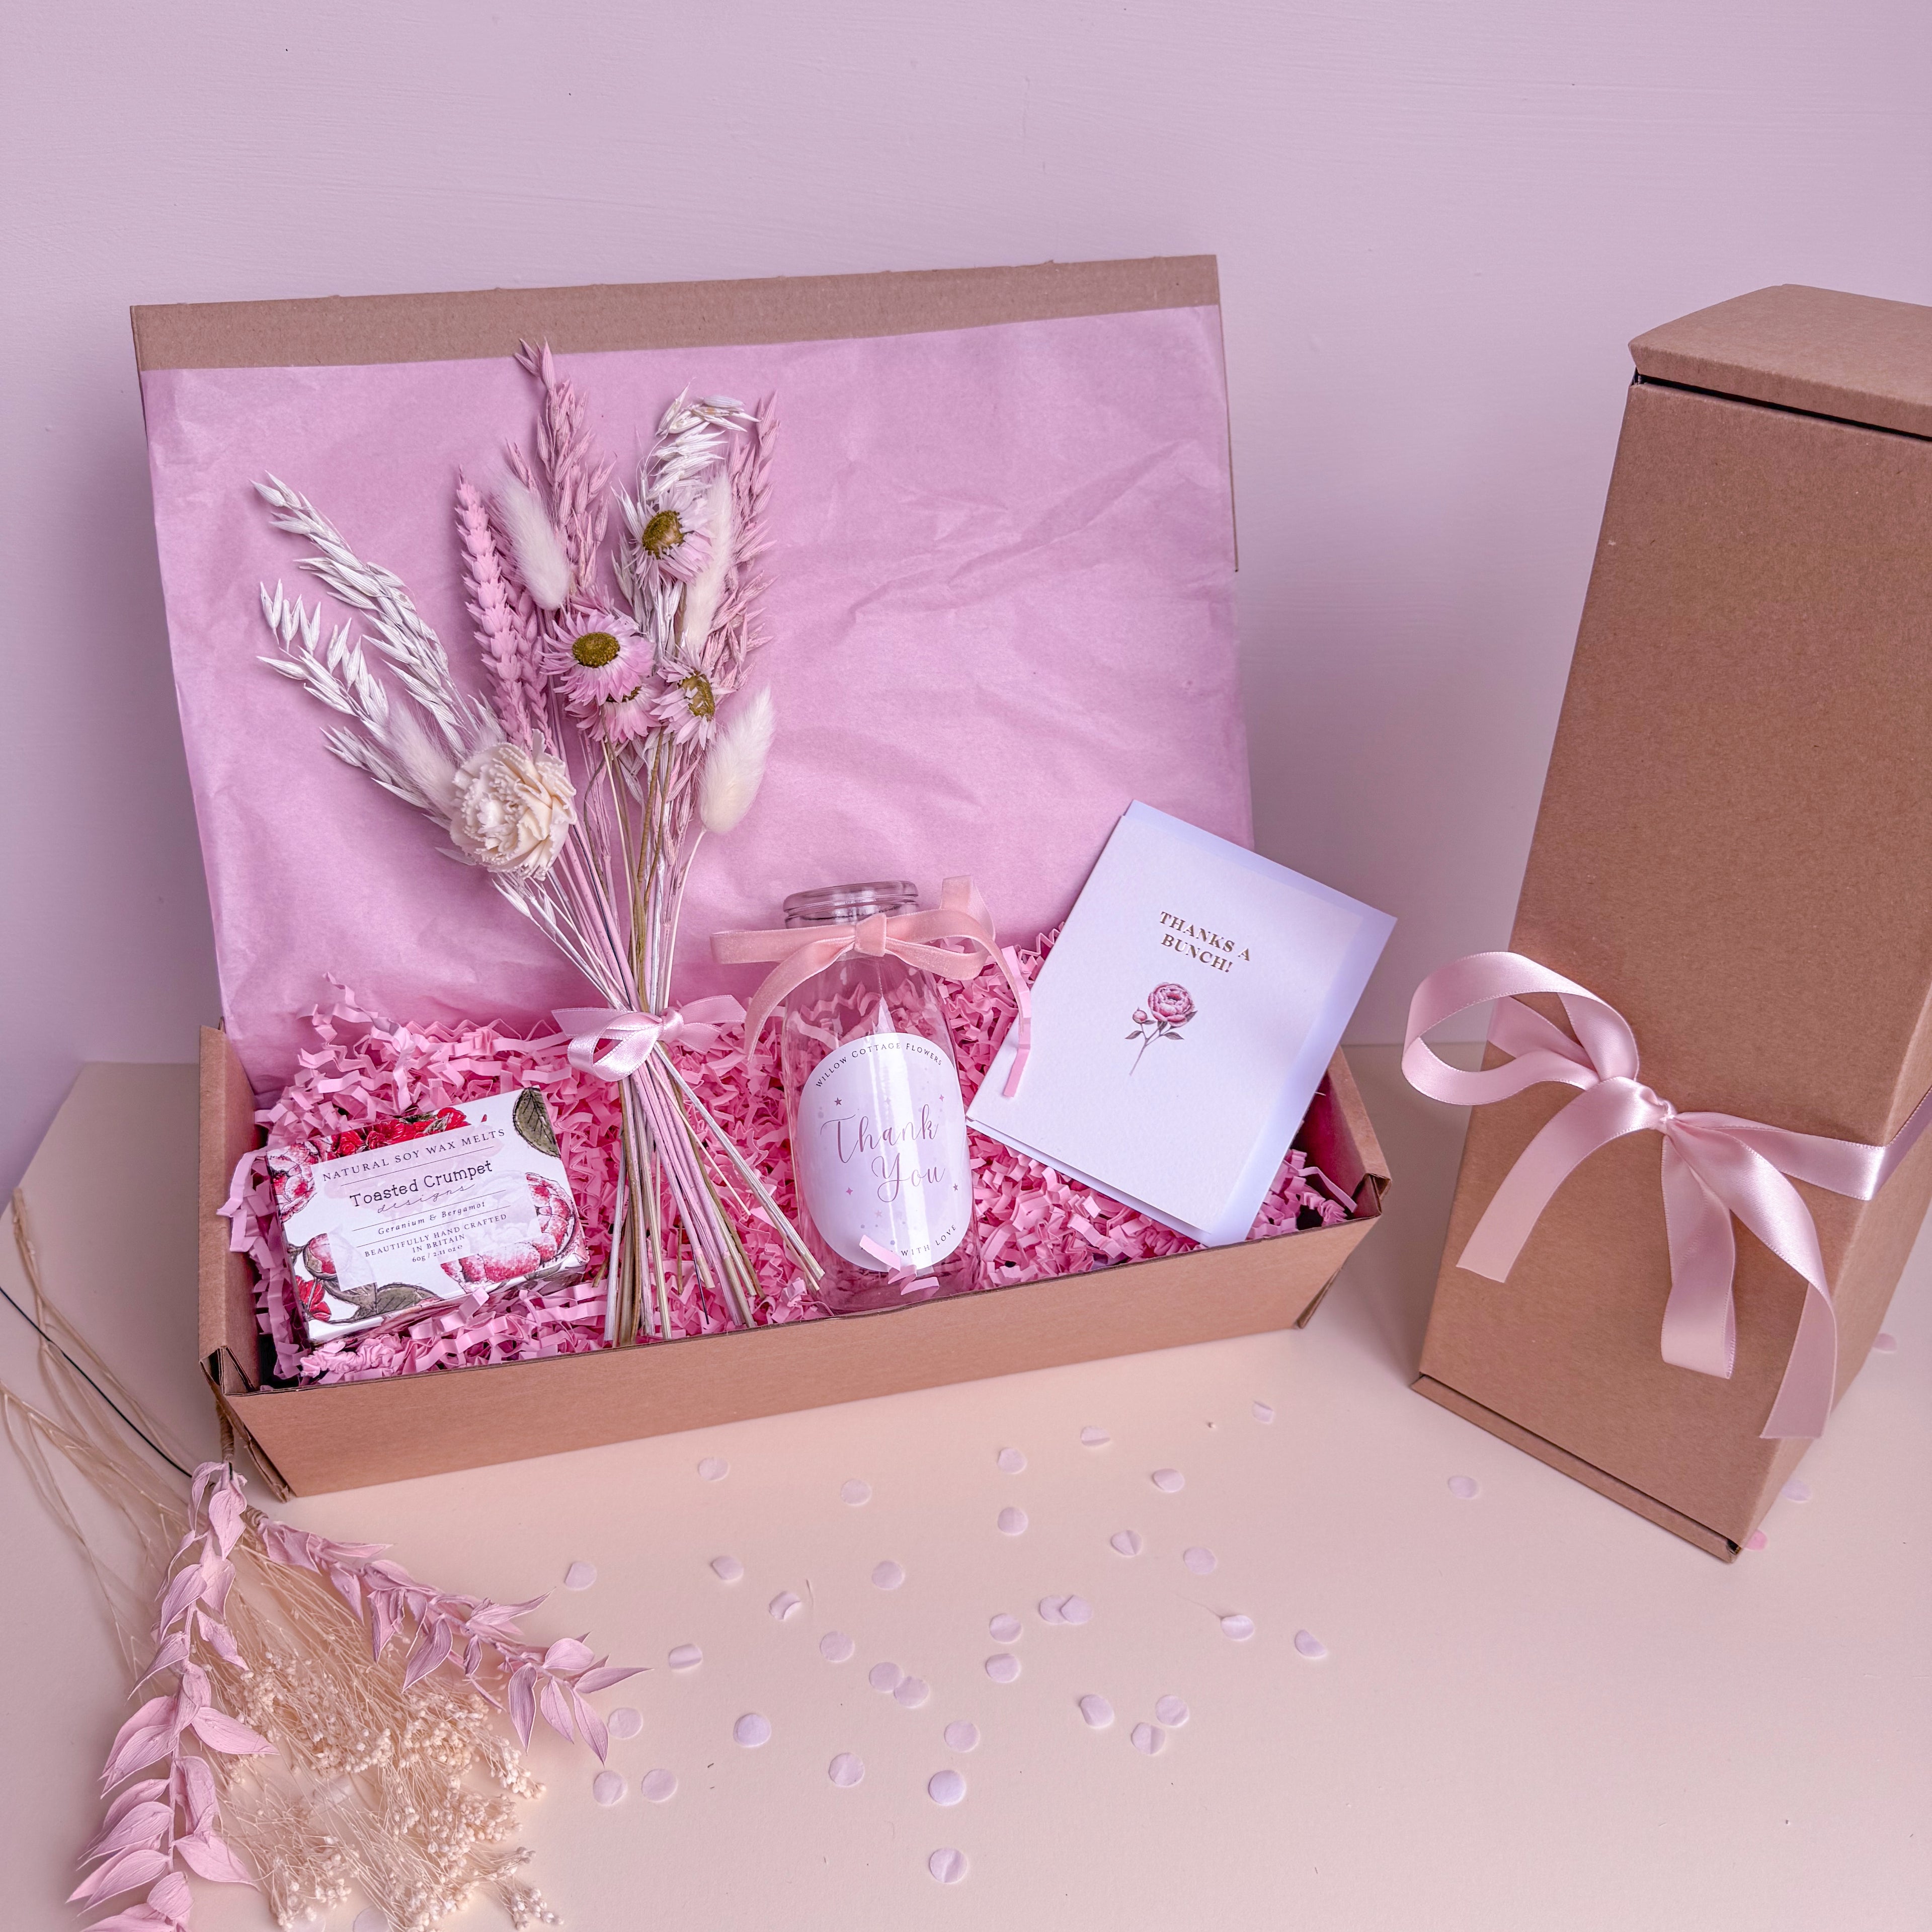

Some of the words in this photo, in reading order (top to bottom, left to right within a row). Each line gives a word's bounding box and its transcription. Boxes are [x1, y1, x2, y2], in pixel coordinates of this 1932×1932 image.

[1159, 911, 1235, 953] THANKS
[1238, 948, 1251, 961] A
[1161, 933, 1233, 973] BUNCH!
[816, 1057, 847, 1087] WILLOW
[852, 1043, 901, 1058] COTTAGE
[906, 1043, 942, 1066] FLOWERS
[323, 1159, 389, 1181] NATURAL
[395, 1150, 420, 1163] SOY
[426, 1142, 456, 1155] WAX
[461, 1129, 505, 1146] MELTS
[820, 1104, 939, 1164] Thank
[350, 1179, 419, 1207] Toasted
[424, 1161, 492, 1188] Crumpet
[377, 1184, 475, 1213] designs
[871, 1152, 946, 1203] You
[365, 1235, 429, 1257] BEAUTIFULLY
[434, 1227, 460, 1238] HAND
[464, 1214, 507, 1230] CRAFTED
[378, 1219, 425, 1235] Geranium
[442, 1201, 485, 1218] Bergamot
[427, 1234, 465, 1249] BRITAIN
[901, 1245, 930, 1256] WITH
[935, 1225, 956, 1246] LOVE
